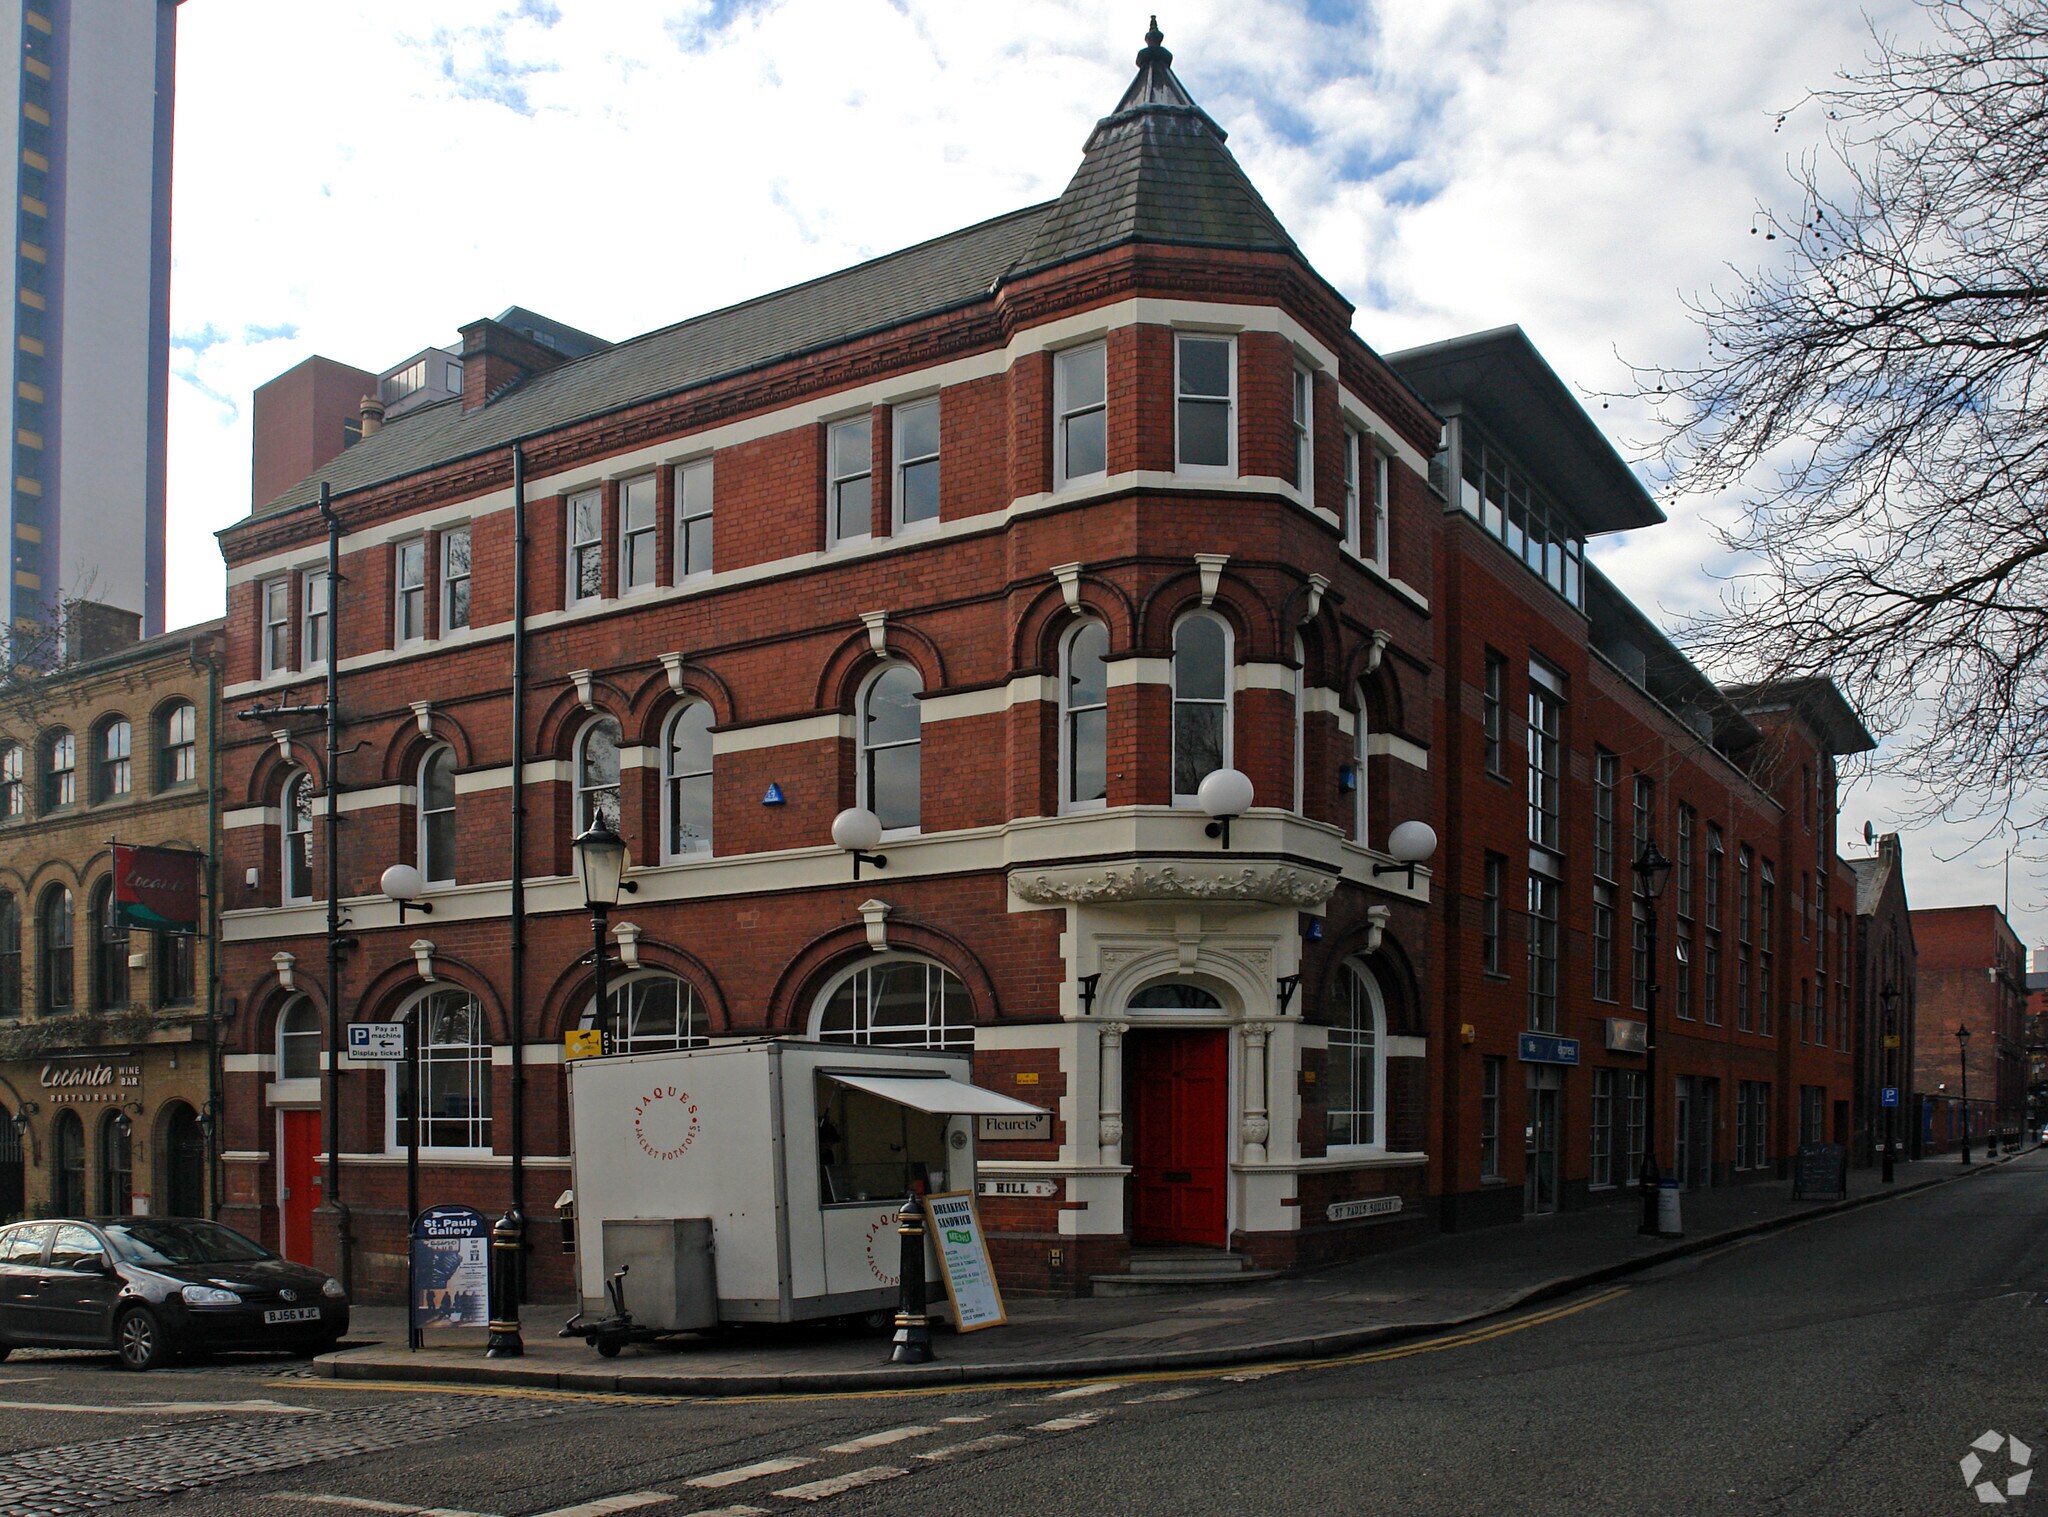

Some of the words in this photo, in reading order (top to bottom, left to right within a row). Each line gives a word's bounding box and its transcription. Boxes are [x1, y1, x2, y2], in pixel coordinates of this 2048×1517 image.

[355, 1030, 367, 1044] P
[40, 1063, 114, 1088] Locanta
[118, 1066, 140, 1075] WINE
[121, 1077, 138, 1086] BAR
[50, 1093, 126, 1102] RESTAURANT
[634, 1086, 698, 1116] JAQUES
[1886, 1090, 1895, 1099] P
[986, 1118, 1037, 1131] Fleurets
[635, 1127, 659, 1159] JACKET
[661, 1125, 697, 1160] POTATOES
[996, 1183, 1028, 1194] HILL
[933, 1201, 969, 1215] BREAKFAST
[1335, 1208, 1343, 1218] ST
[1347, 1205, 1367, 1216] PAULS
[1370, 1201, 1392, 1213] SQUARE
[423, 1219, 441, 1228] St.
[443, 1218, 478, 1227] Pauls
[865, 1213, 899, 1243] JAQU
[937, 1215, 972, 1228] SANDWICH
[427, 1226, 474, 1236] Gallery
[948, 1232, 970, 1242] MENU
[867, 1255, 888, 1284] JACKET
[269, 1310, 296, 1321] BJ56
